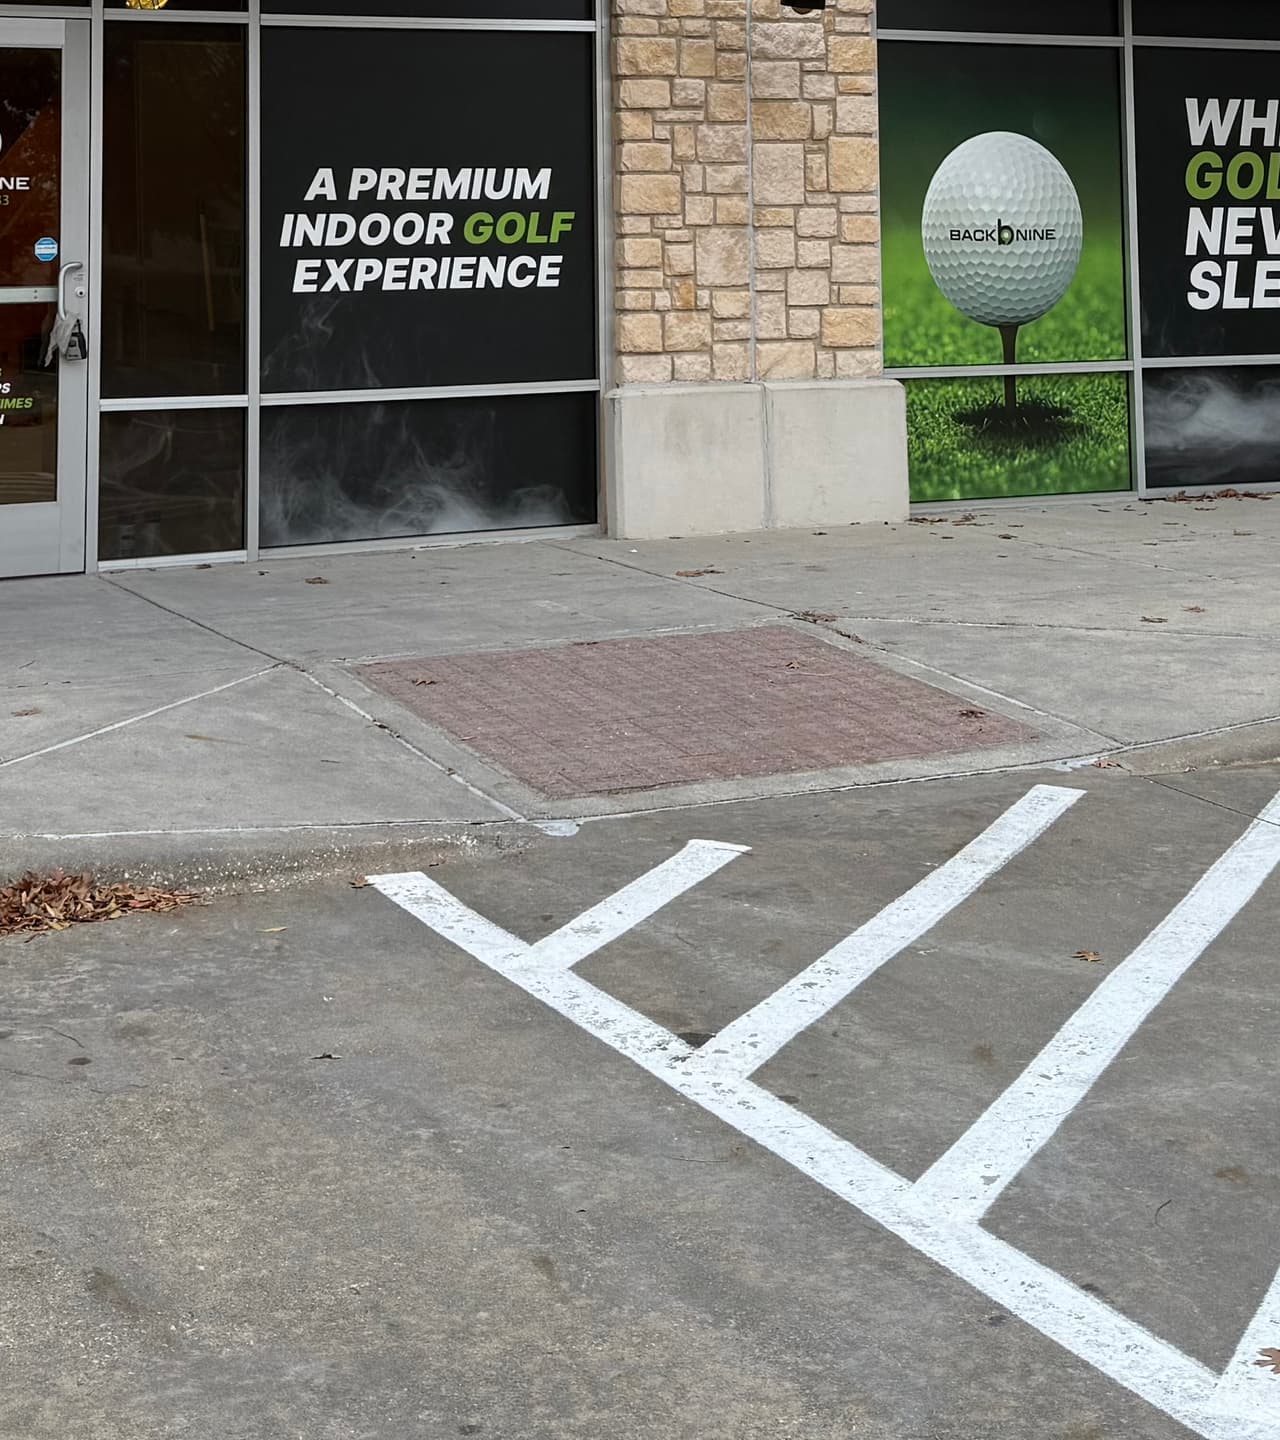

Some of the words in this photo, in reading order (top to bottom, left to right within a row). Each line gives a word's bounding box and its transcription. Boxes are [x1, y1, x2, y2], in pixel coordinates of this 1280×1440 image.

[304, 167, 337, 201] A
[348, 167, 552, 201] PREMIUM
[279, 212, 454, 247] INDOOR
[463, 211, 576, 245] GOLF
[949, 228, 996, 242] BACK
[1016, 228, 1056, 241] NINE
[292, 255, 563, 293] EXPERIENCE
